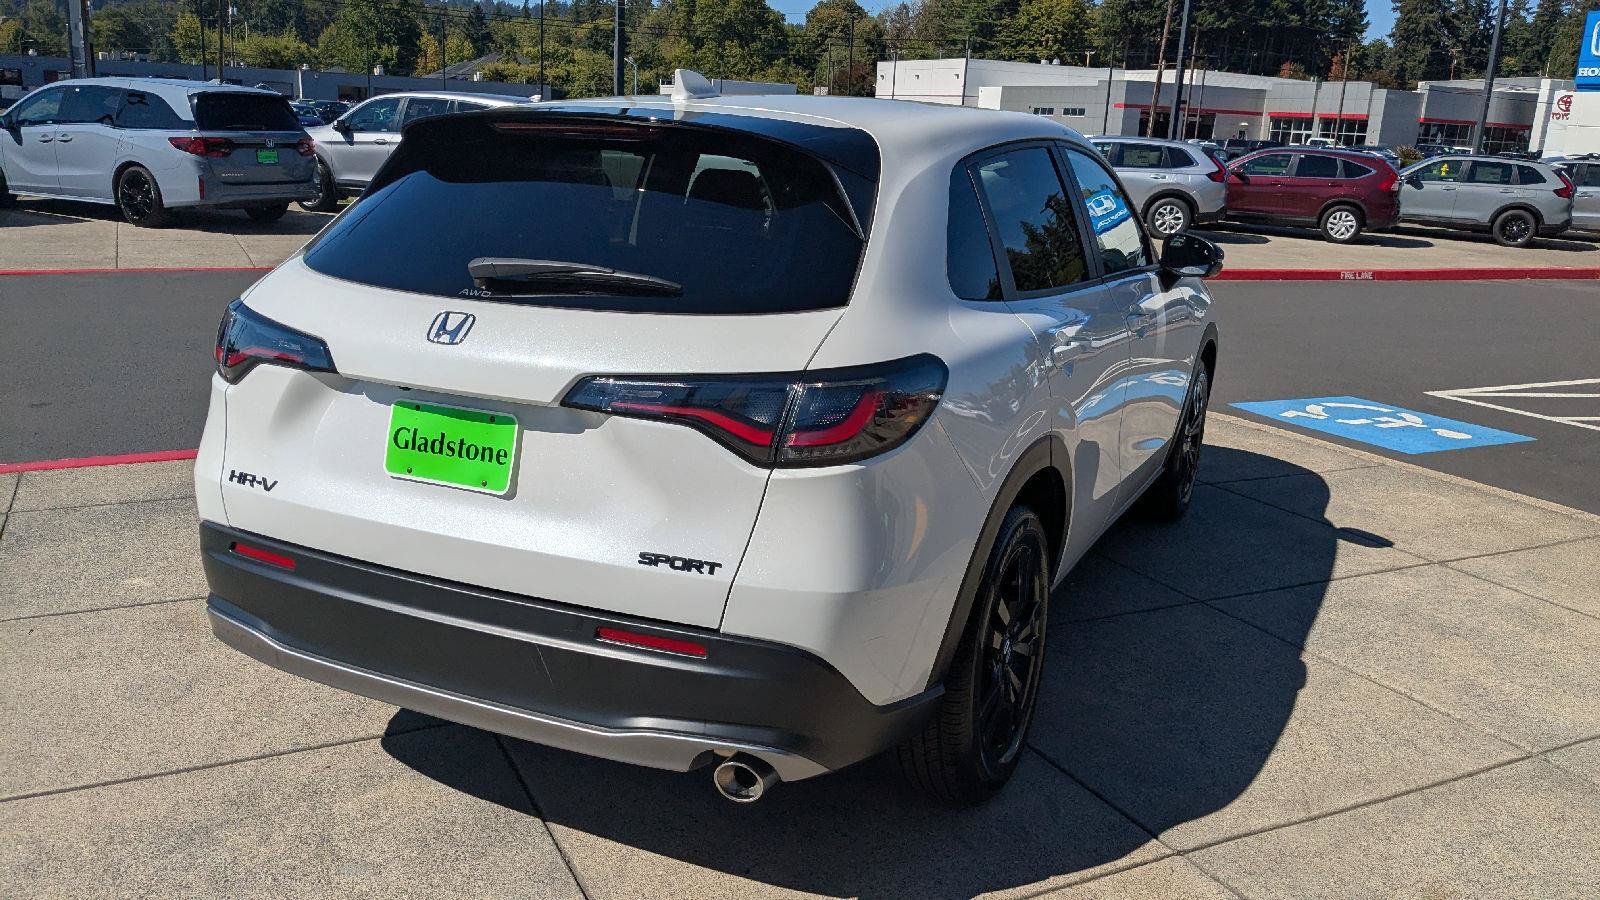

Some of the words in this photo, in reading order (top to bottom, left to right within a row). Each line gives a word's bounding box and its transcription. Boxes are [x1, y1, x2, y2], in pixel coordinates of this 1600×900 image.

[1340, 271, 1355, 280] FIRE
[1356, 271, 1373, 280] LANE
[458, 288, 491, 298] AWD
[393, 426, 508, 466] Gladstone
[228, 469, 279, 492] HR-V
[637, 551, 723, 576] SPORT
